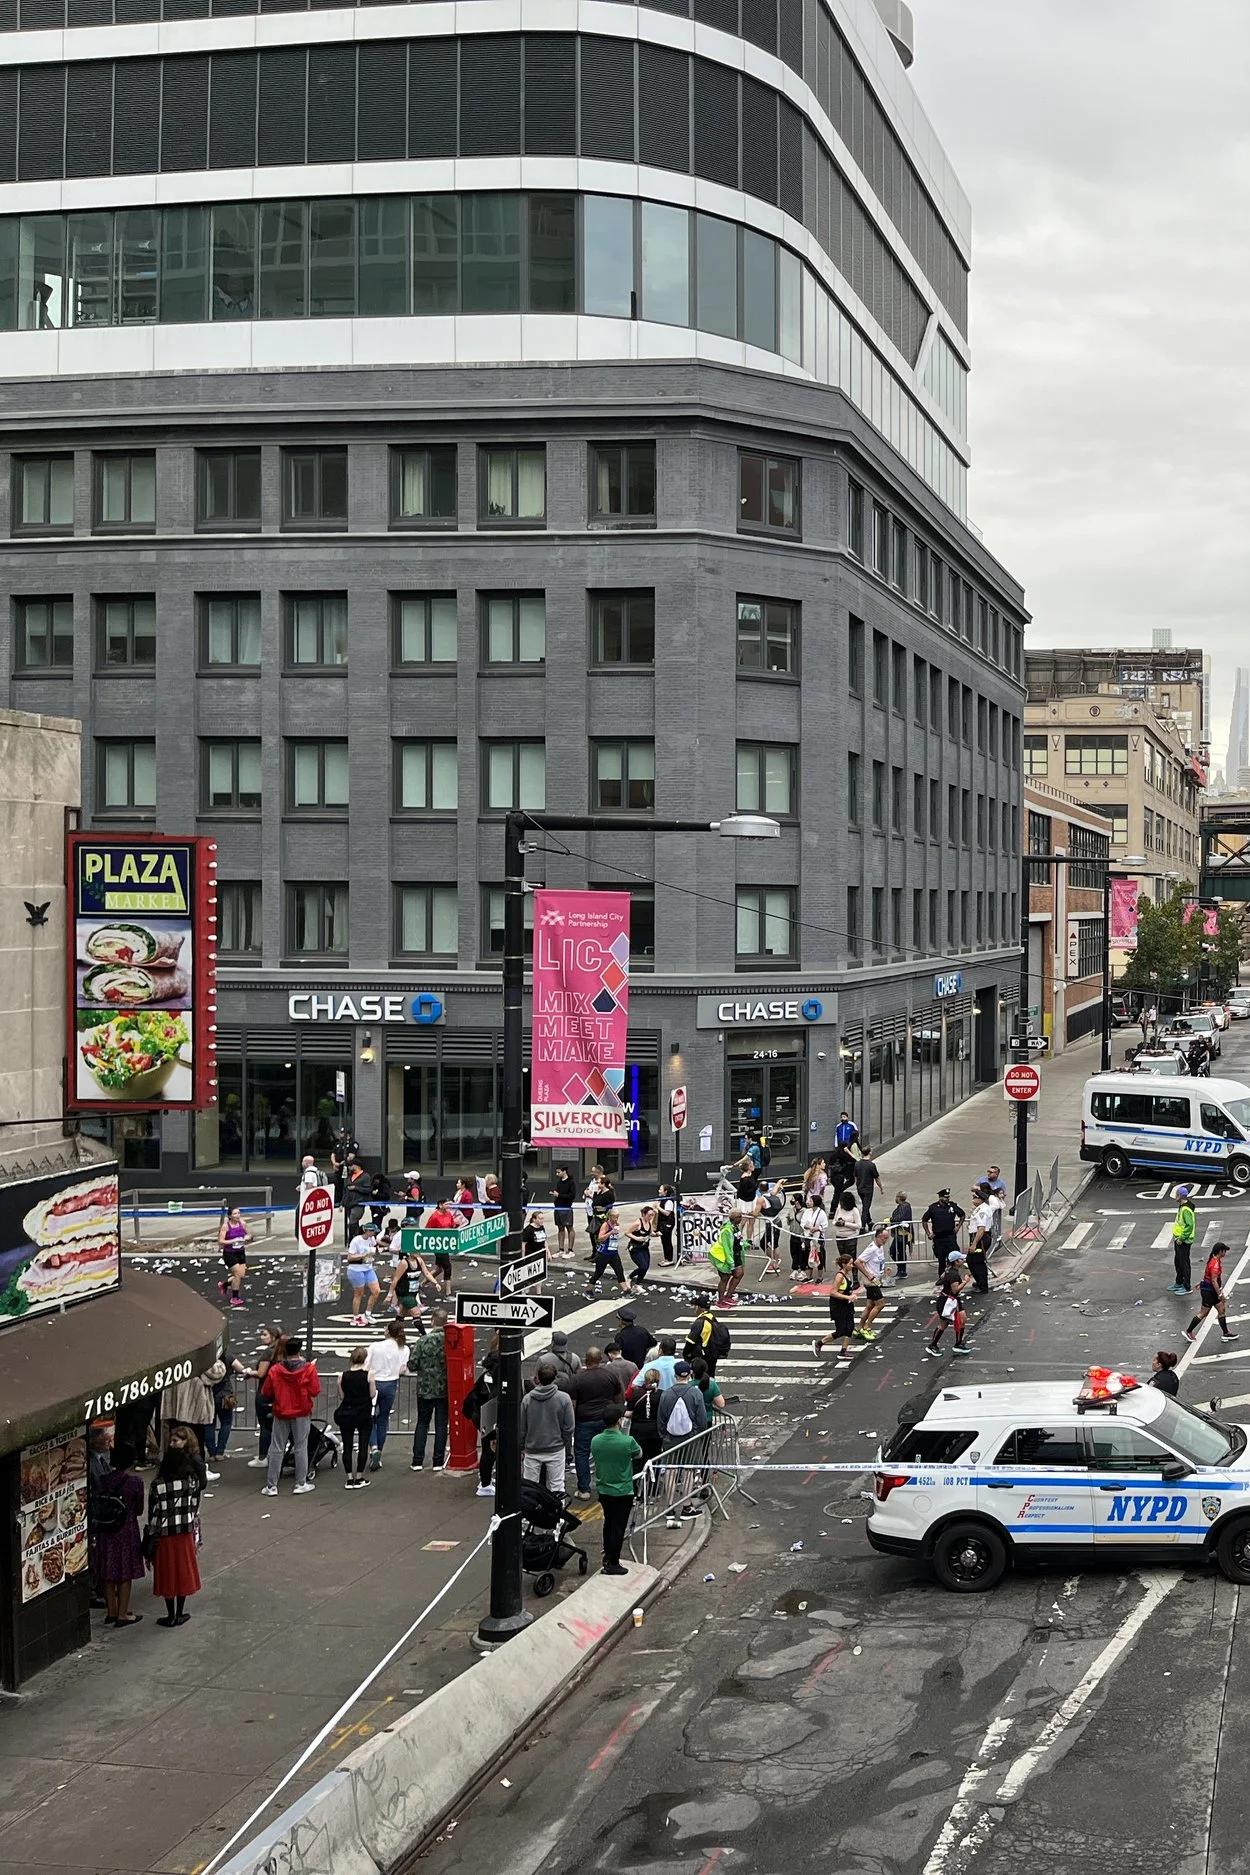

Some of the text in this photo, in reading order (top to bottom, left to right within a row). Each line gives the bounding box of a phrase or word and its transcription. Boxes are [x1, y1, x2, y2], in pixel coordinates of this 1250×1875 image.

[85, 853, 180, 884] PLAZA
[106, 892, 185, 910] MARKET
[568, 912, 624, 922] Long Island City
[568, 920, 608, 928] Partnership
[538, 930, 602, 988] LIC
[938, 975, 957, 997] CHASE
[288, 994, 406, 1021] CHASE
[538, 985, 591, 1014] MIX
[718, 1001, 799, 1022] CHASE
[538, 1015, 614, 1040] MEET
[538, 1040, 615, 1064] MAKE
[534, 1112, 622, 1132] SILVERCUP
[1184, 1140, 1222, 1154] NYPD
[305, 1198, 329, 1212] DO NOT
[306, 1225, 326, 1238] ENTER
[460, 1216, 505, 1244] QUEENS PLAZA
[683, 1216, 722, 1233] DRAG
[414, 1232, 460, 1250] Cresce
[477, 1235, 489, 1245] SOUTH
[508, 1262, 542, 1286] ONE WAY
[470, 1304, 539, 1318] ONE WAY
[84, 1360, 192, 1420] 718.786.8200
[30, 1442, 49, 1456] TACOS
[956, 1476, 968, 1485] PCT
[34, 1495, 48, 1508] RICE
[55, 1484, 75, 1499] BEANS
[1107, 1496, 1188, 1522] NYPD
[26, 1541, 50, 1558] FAJITAS
[56, 1522, 85, 1542] BURRITOS
